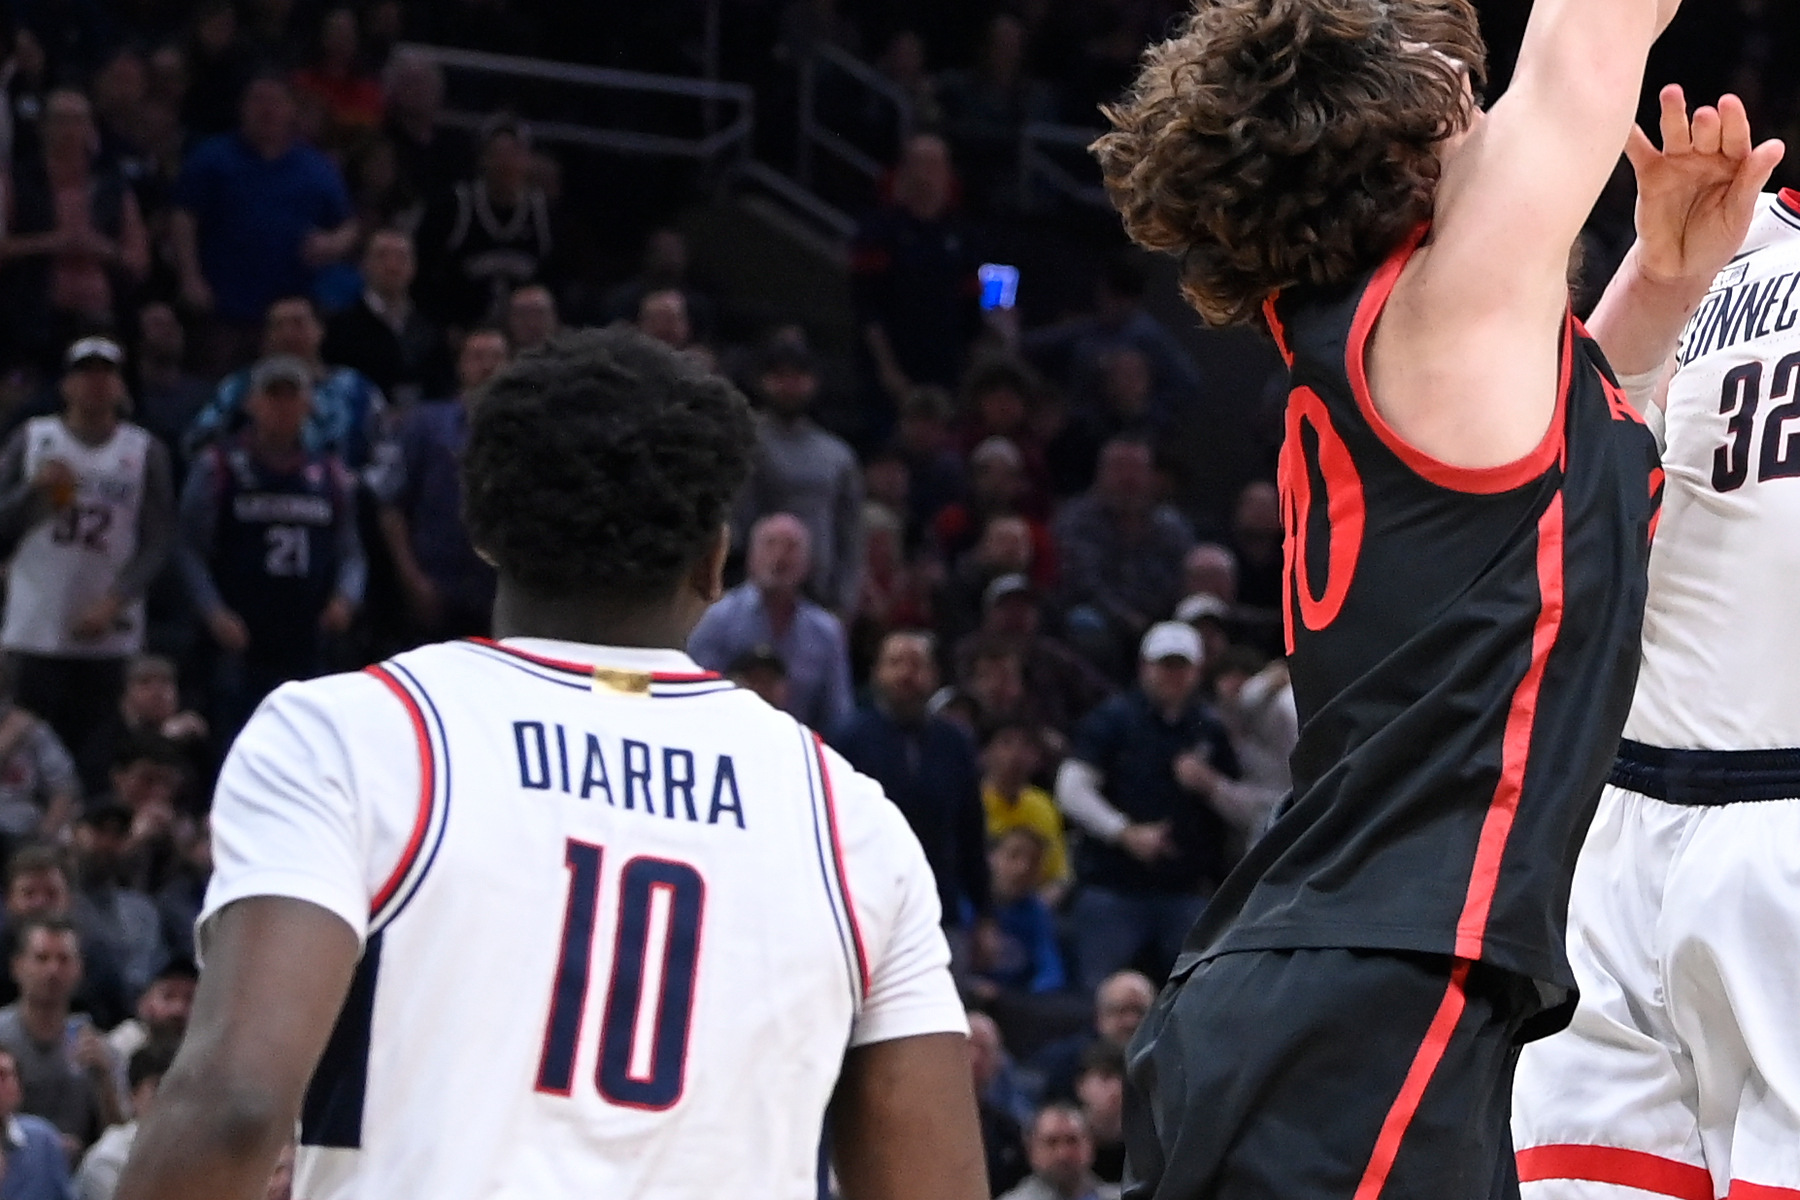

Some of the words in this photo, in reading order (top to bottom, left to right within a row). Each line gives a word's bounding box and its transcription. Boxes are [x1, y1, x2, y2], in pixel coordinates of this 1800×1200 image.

[263, 524, 312, 579] 21
[1276, 384, 1367, 657] 0
[512, 719, 746, 831] DIARRA
[533, 836, 707, 1113] 10
